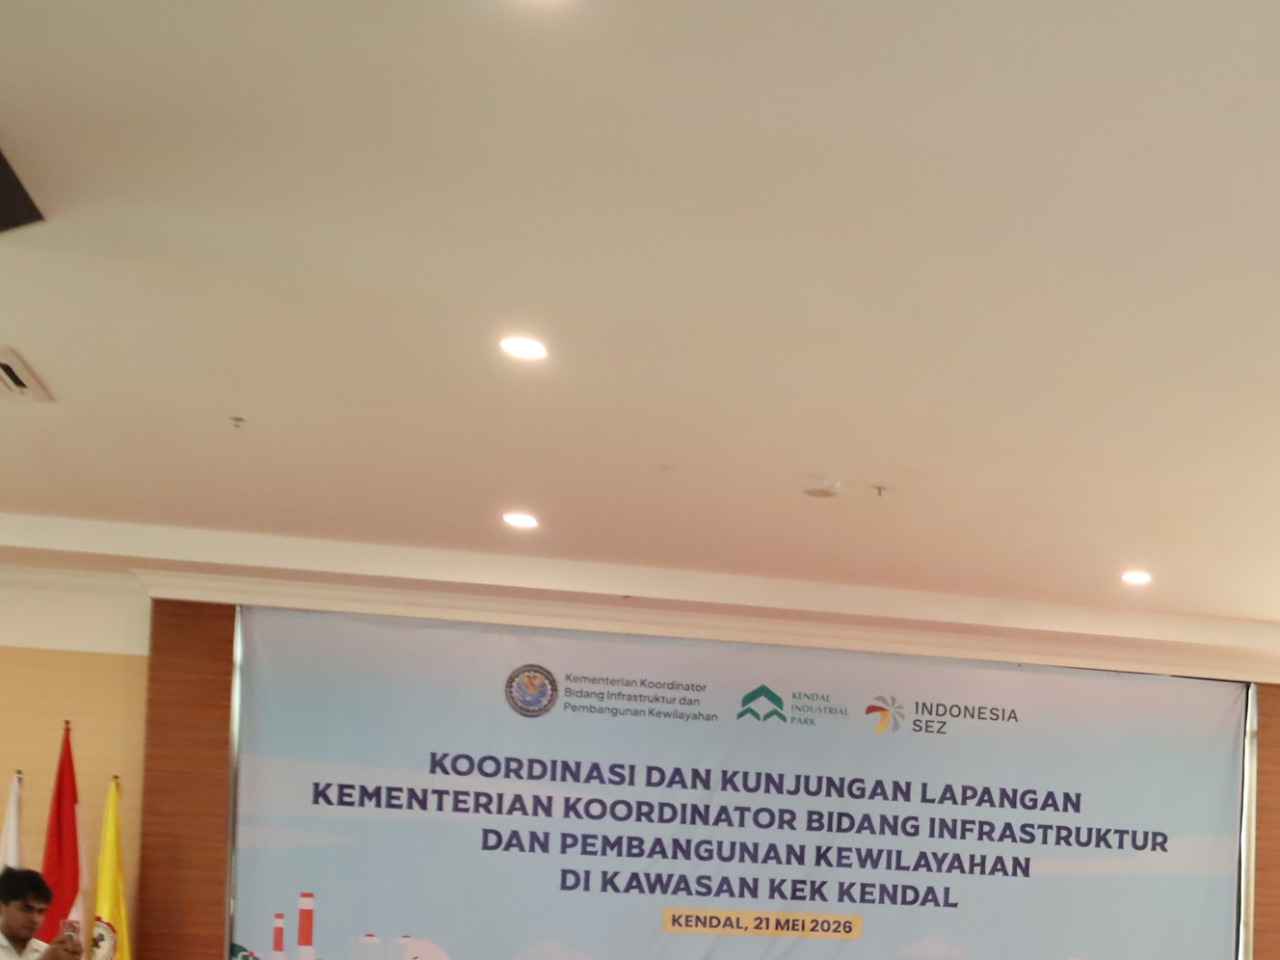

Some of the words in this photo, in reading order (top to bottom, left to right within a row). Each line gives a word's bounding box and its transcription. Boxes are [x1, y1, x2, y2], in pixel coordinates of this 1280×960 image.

[564, 673, 638, 688] Kementerian
[639, 678, 707, 692] Koordinator
[564, 687, 605, 701] Bidang
[606, 689, 676, 704] Infrastruktur
[678, 695, 700, 706] dan
[791, 691, 832, 703] KENDAL
[563, 702, 646, 717] Pembangunan
[647, 707, 719, 722] Kewilayahan
[790, 703, 849, 716] INDUSTRIAL
[914, 701, 1019, 723] INDONESIA
[790, 716, 816, 727] PARK
[912, 719, 947, 734] SEZ
[428, 752, 636, 787] KOORDINASI
[644, 765, 712, 790] DAN
[720, 769, 912, 803] KUNJUNGAN
[920, 782, 1082, 813] LAPANGAN
[311, 782, 553, 818] KEMENTERIAN
[562, 796, 797, 831] KOORDINATOR
[805, 810, 920, 837] BIDANG
[928, 817, 1169, 852] INFRASTRUKTUR
[481, 828, 551, 854] DAN
[559, 833, 806, 866] PEMBANGUNAN
[814, 845, 1031, 878] KEWILAYAHAN
[559, 868, 591, 892] DI
[600, 871, 759, 900] KAWASAN
[768, 879, 830, 902] KEK
[836, 882, 959, 909] KENDAL
[670, 914, 749, 933] KENDAL,
[753, 917, 773, 931] 21
[775, 917, 806, 932] MEI
[809, 918, 853, 935] 2026
